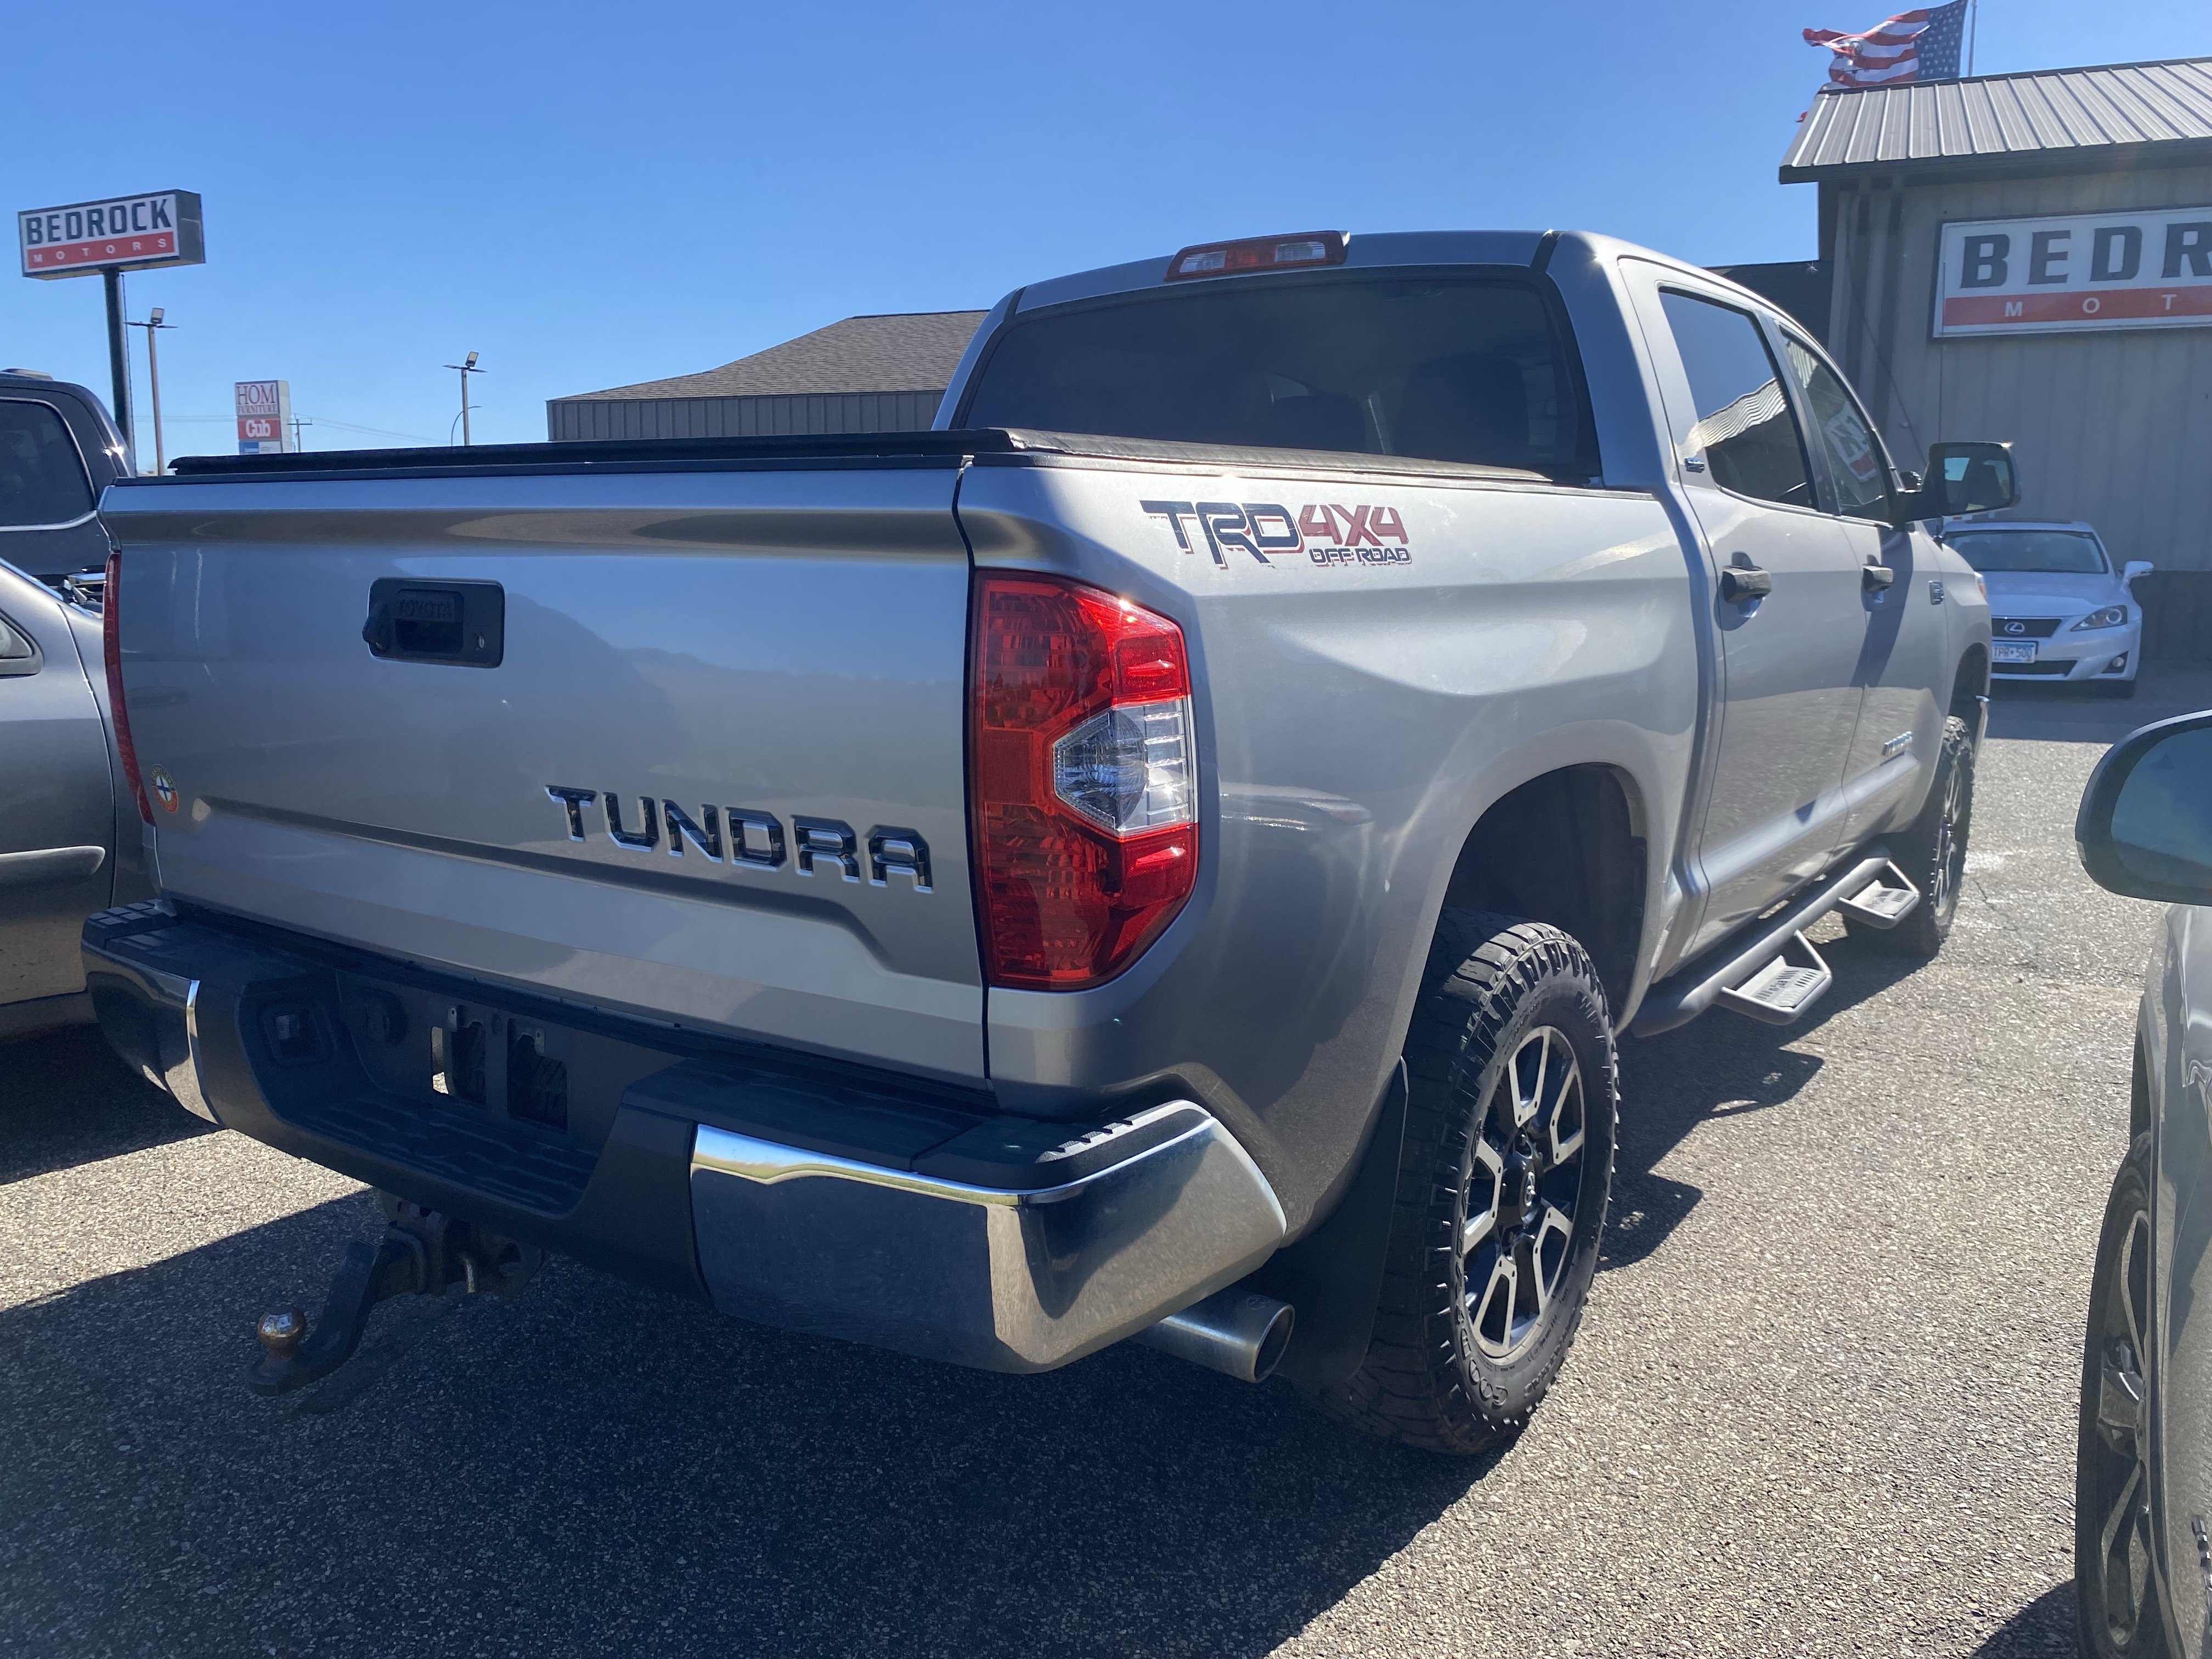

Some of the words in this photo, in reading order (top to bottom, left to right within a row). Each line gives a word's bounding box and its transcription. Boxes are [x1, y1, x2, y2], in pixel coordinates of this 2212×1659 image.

[26, 199, 172, 245] BEDROCK
[33, 238, 167, 263] MOTORS
[1960, 222, 2212, 289] BEDR
[2005, 294, 2177, 318] MOT
[236, 385, 275, 405] HOM
[238, 404, 277, 414] FURNITURE
[245, 419, 272, 438] Cub
[1138, 500, 1304, 569] TRD
[1309, 548, 1355, 566] OFF
[1355, 548, 1413, 565] ROAD
[545, 785, 934, 894] TUNDRA
